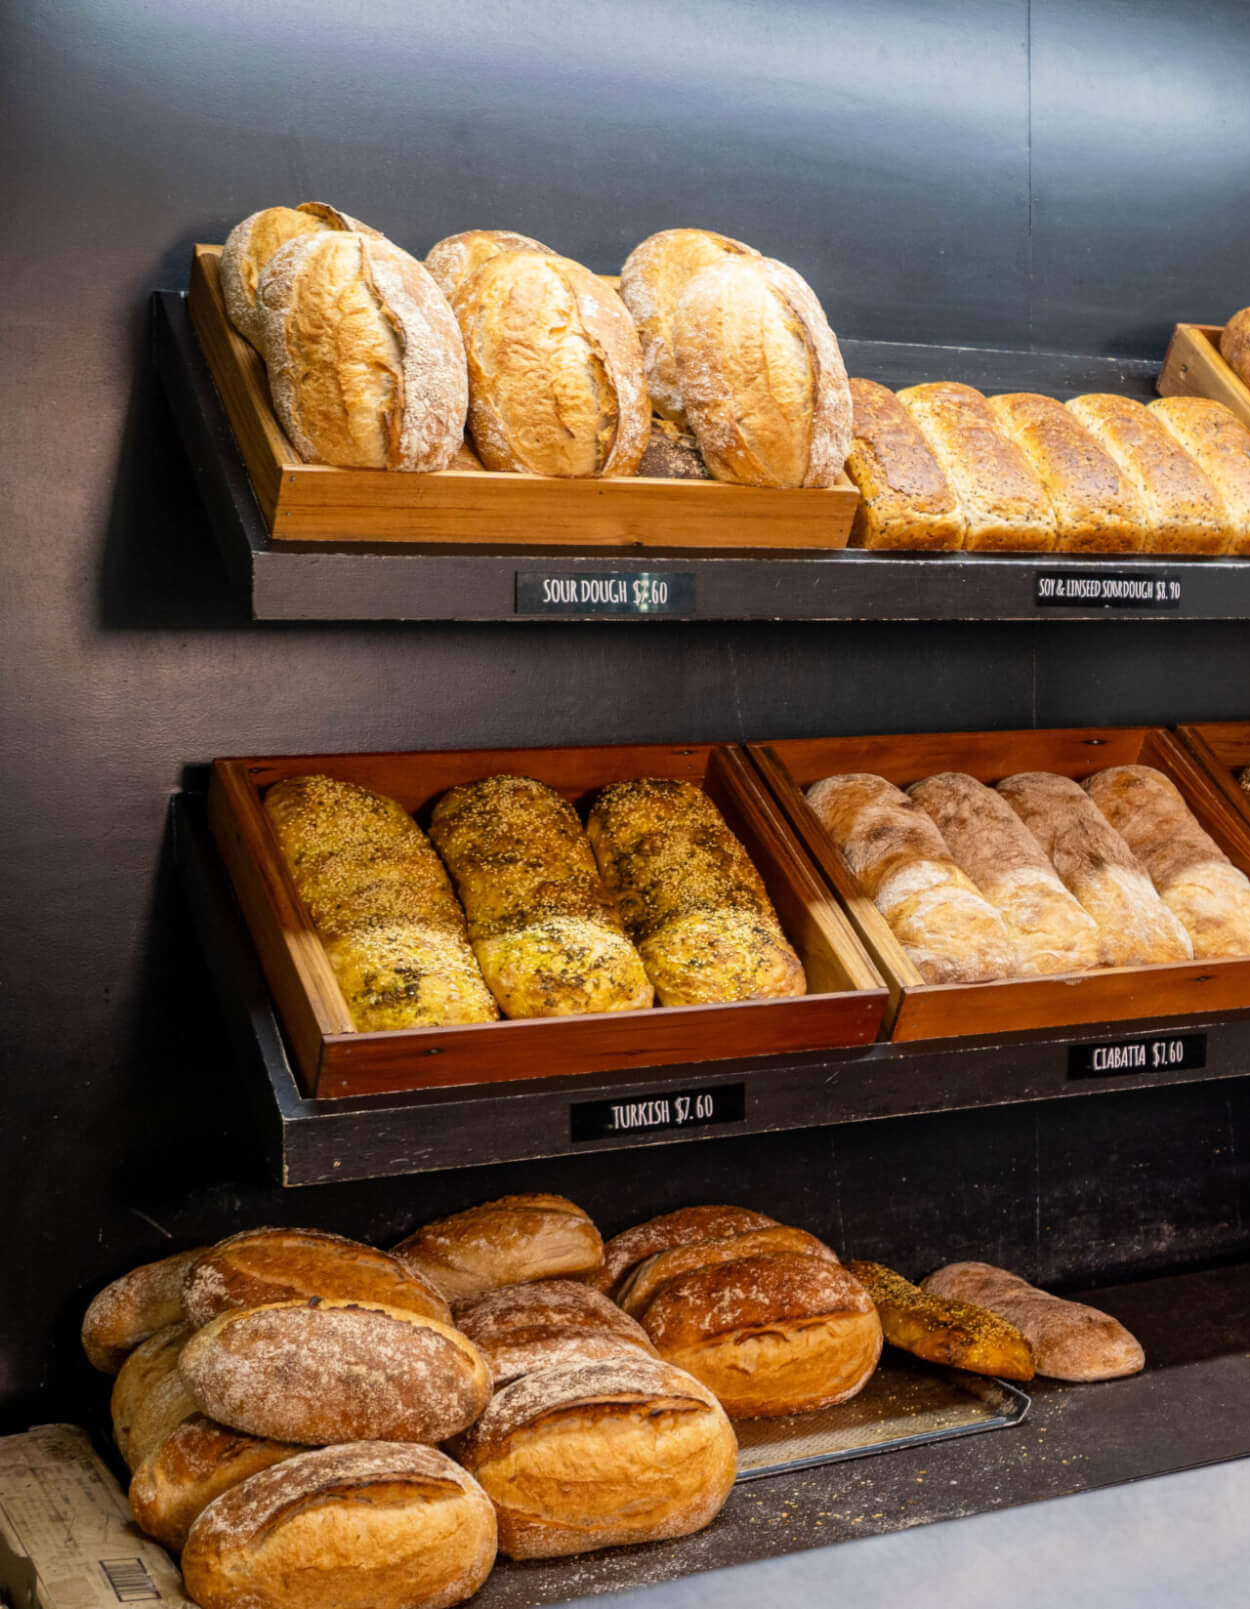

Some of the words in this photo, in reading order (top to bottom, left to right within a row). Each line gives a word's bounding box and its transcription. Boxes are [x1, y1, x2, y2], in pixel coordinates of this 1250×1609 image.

[543, 579, 578, 603] SOUR
[581, 579, 627, 603] DOUGH
[1039, 578, 1056, 597] SOY
[1056, 579, 1065, 595] &
[1066, 579, 1100, 598] LINSEED
[1101, 580, 1153, 599] SOURDOUGH
[1093, 1045, 1146, 1071] CIABATTA
[1152, 1040, 1184, 1067] $7.60
[611, 1100, 670, 1129] TURKISH
[674, 1094, 713, 1125] $7.60
